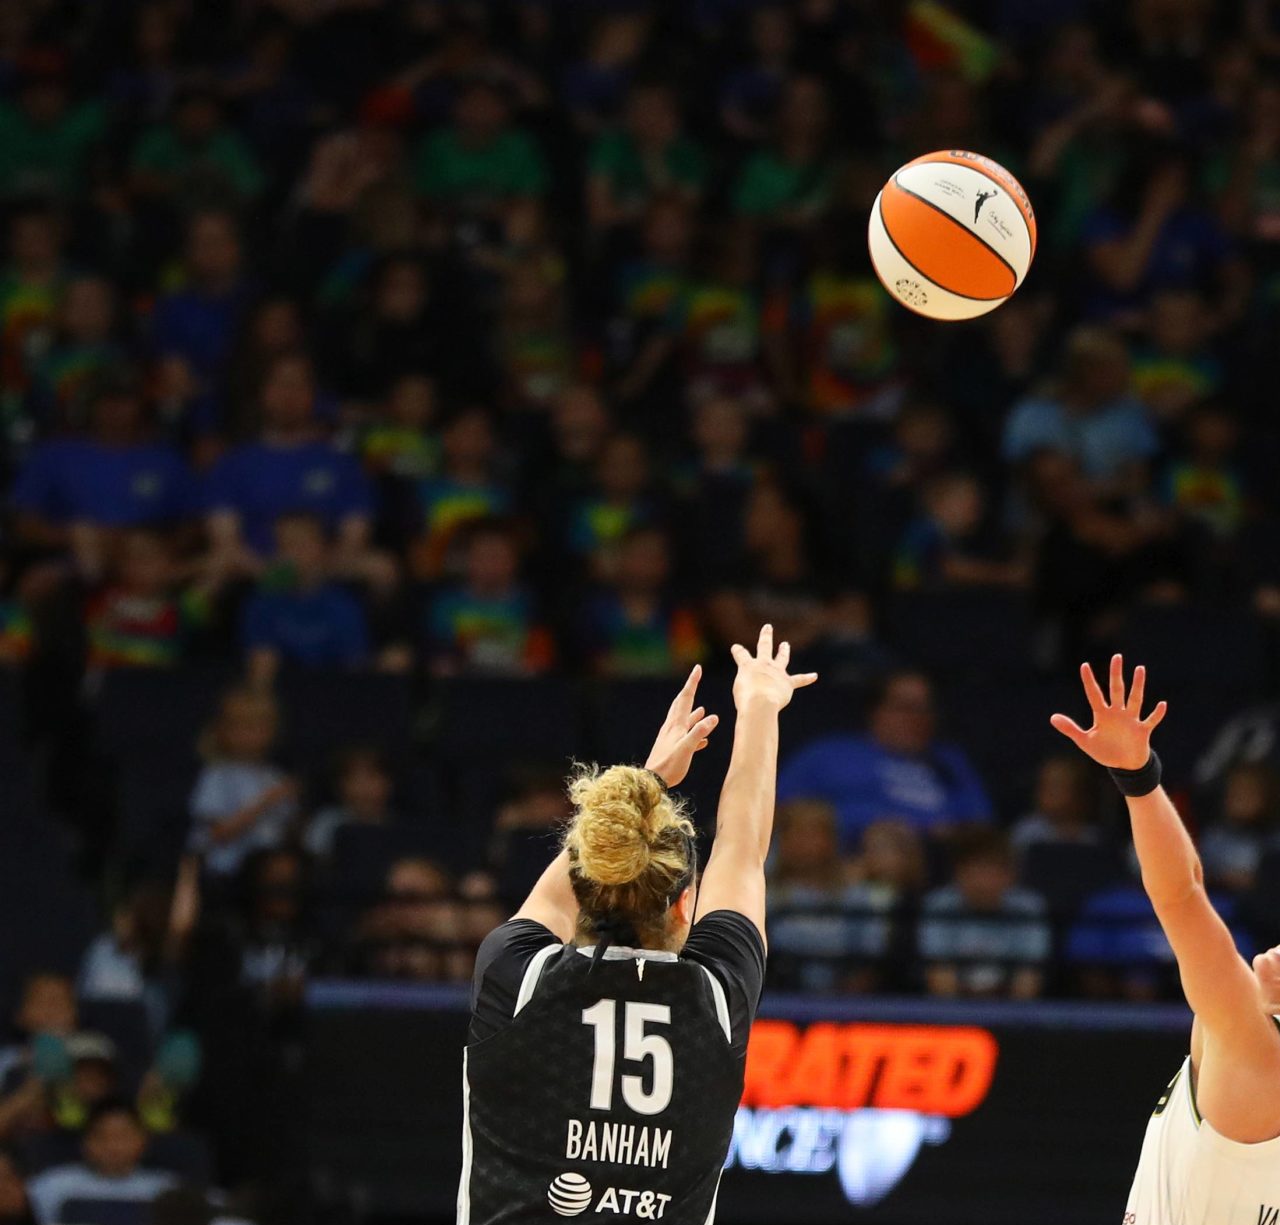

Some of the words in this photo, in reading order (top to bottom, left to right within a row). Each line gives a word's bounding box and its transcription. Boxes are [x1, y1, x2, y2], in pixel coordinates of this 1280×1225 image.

[582, 999, 674, 1115] 15
[566, 1119, 672, 1169] BANHAM
[595, 1187, 672, 1220] AT&T
